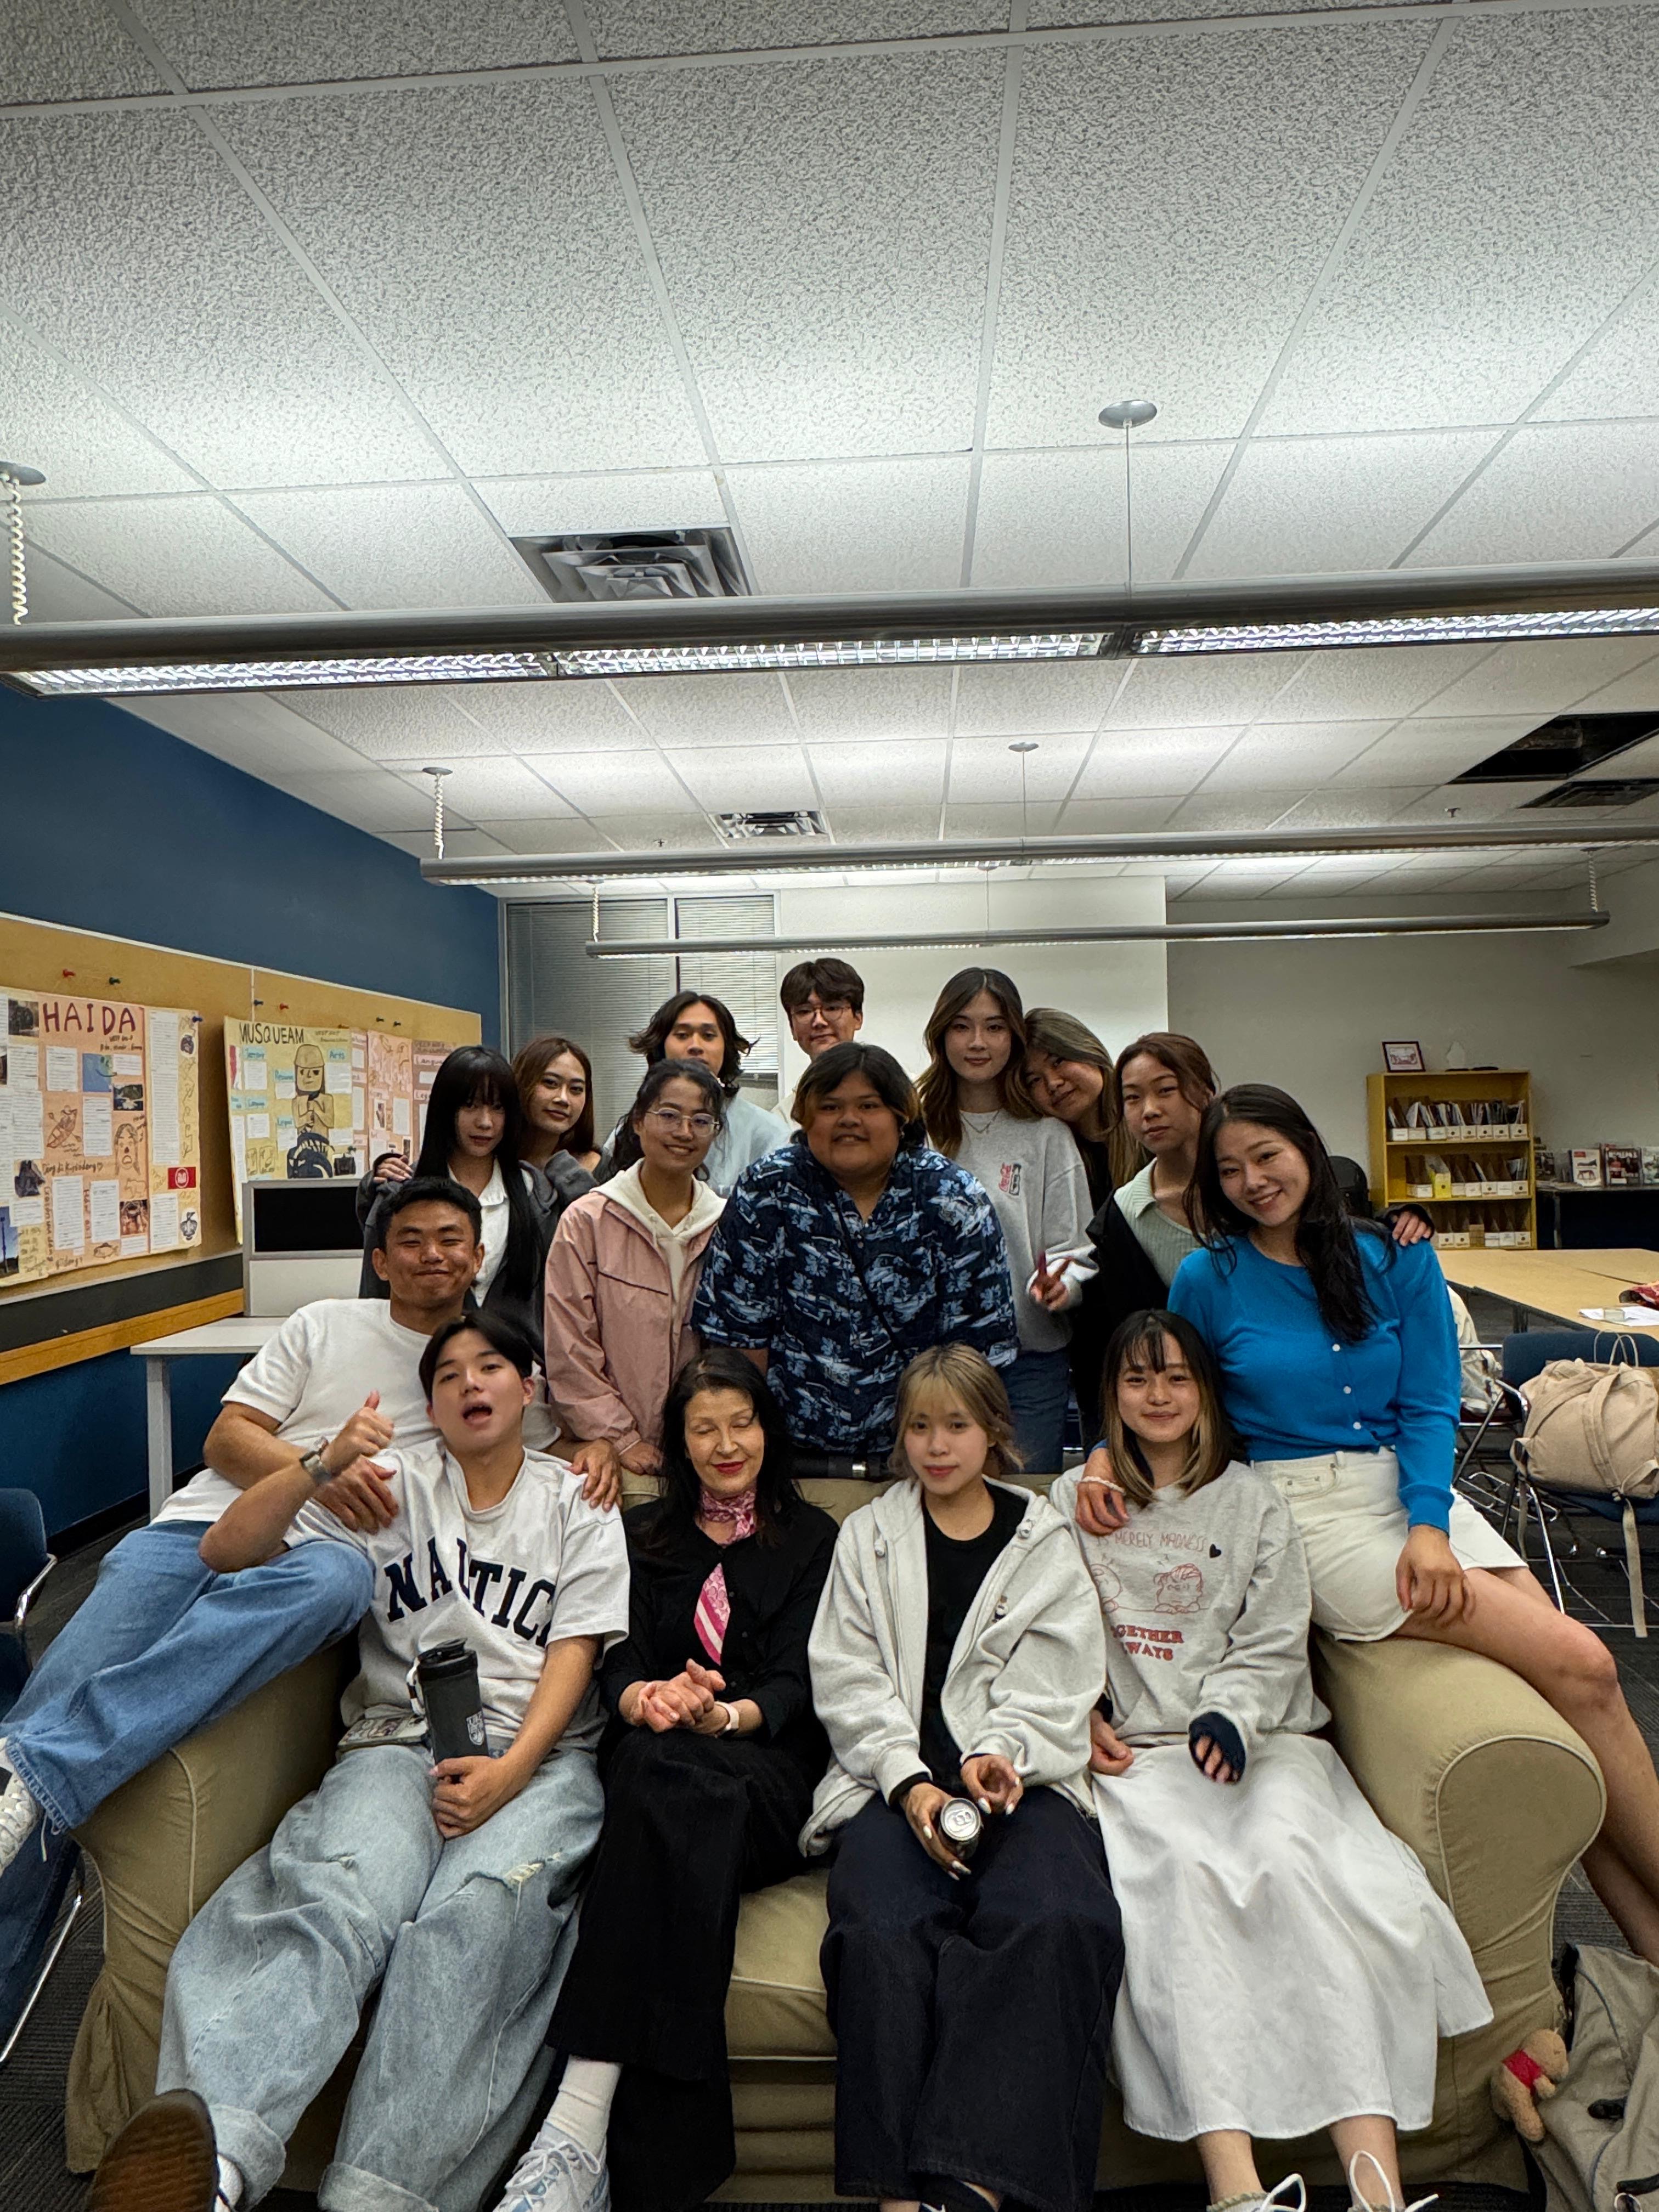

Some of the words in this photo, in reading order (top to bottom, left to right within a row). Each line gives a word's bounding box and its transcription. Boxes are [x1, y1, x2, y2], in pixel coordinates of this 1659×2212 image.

[43, 1002, 136, 1036] HAIDA
[239, 1023, 304, 1045] MUSQUEAM
[1115, 1531, 1154, 1548] MERELY
[1159, 1531, 1207, 1552] MADNESS
[383, 1536, 556, 1649] NAUTIC
[1122, 1641, 1173, 1661] WAYS
